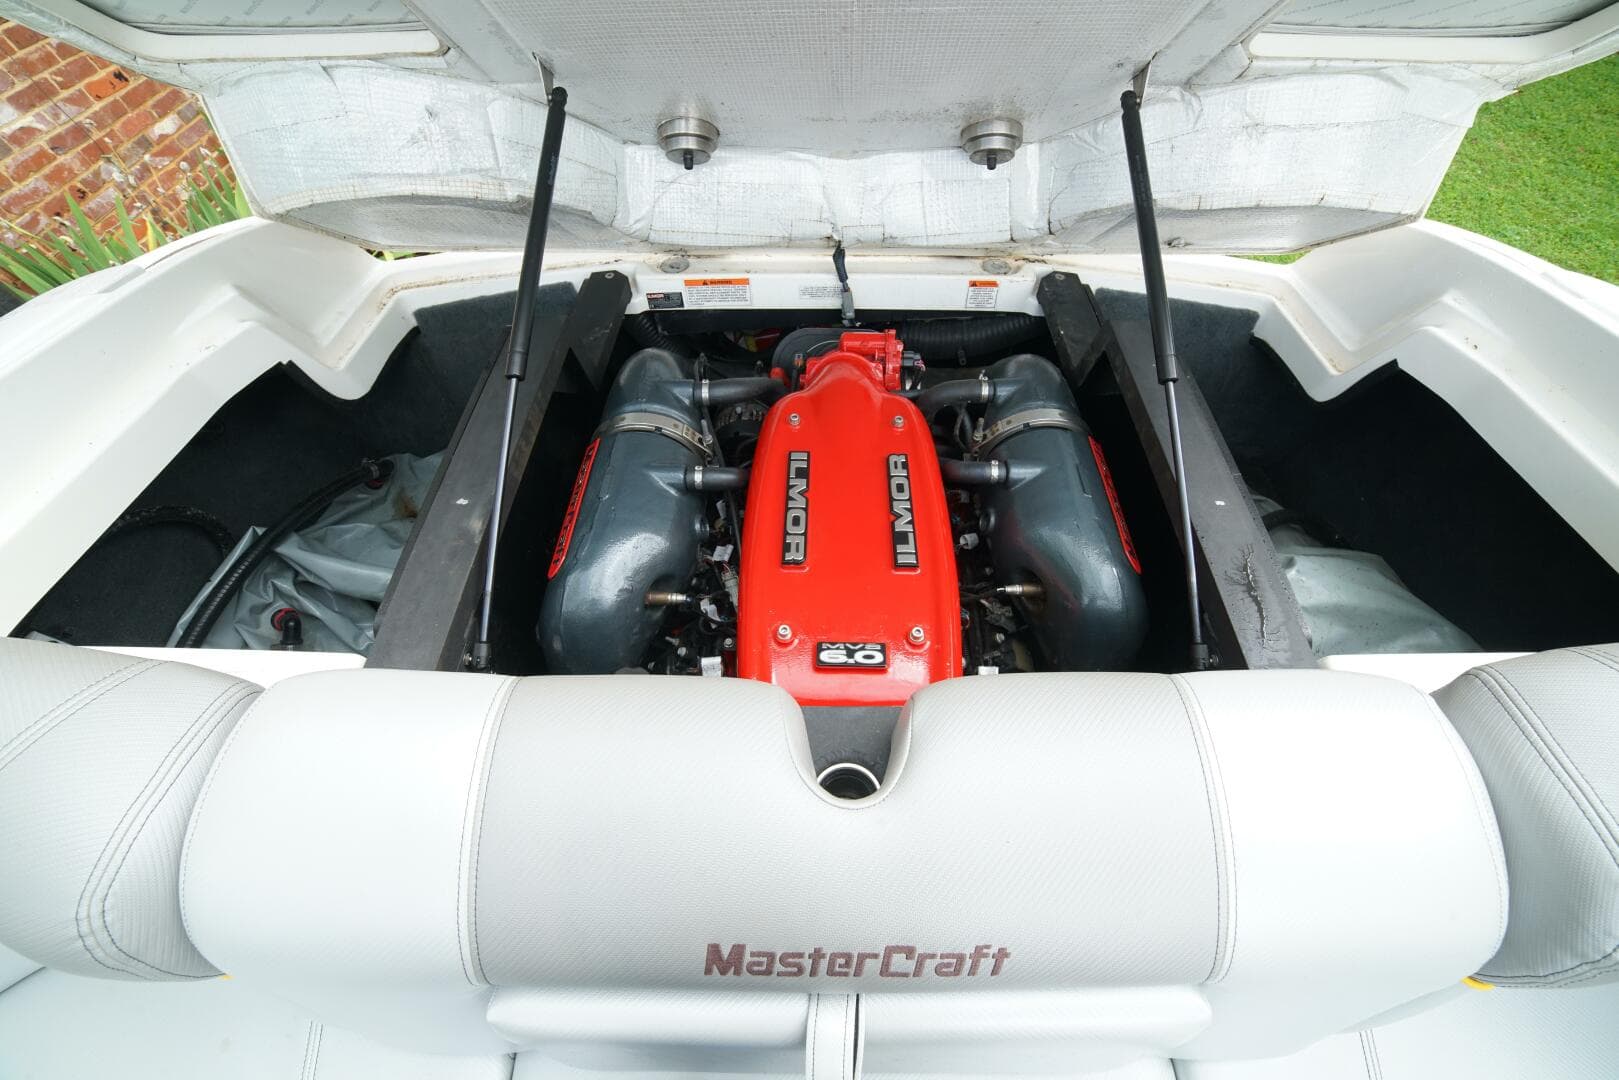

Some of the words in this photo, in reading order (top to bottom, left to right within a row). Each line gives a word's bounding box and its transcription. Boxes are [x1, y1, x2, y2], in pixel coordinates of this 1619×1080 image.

[784, 451, 808, 562] ILMOR
[888, 454, 918, 565] ILMOR
[819, 649, 884, 664] 6.0
[704, 943, 1012, 978] MasterCraft
